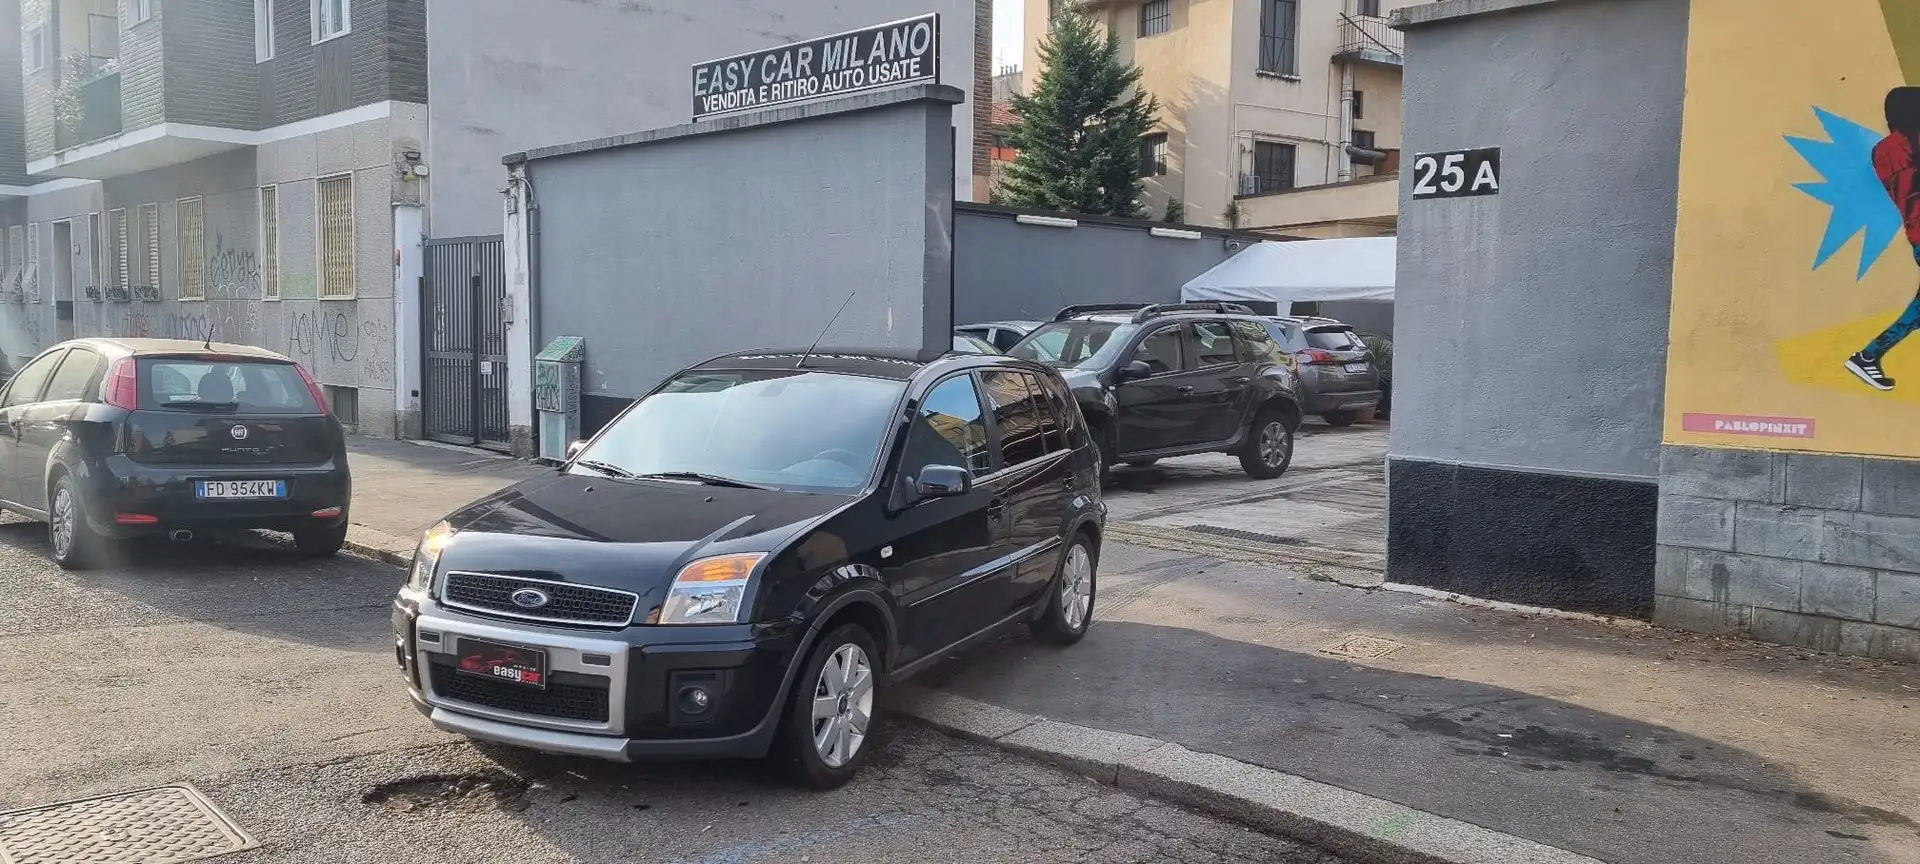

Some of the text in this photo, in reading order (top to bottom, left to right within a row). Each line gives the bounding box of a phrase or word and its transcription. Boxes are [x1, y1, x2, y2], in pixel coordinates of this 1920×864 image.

[694, 22, 931, 97] EASY CAR MILANO
[702, 57, 921, 112] VENDITA E RITIRO AUTO USATE
[1413, 153, 1499, 195] 25 A
[1714, 419, 1808, 435] PABLOPINXIT
[207, 481, 275, 496] FD 954KW
